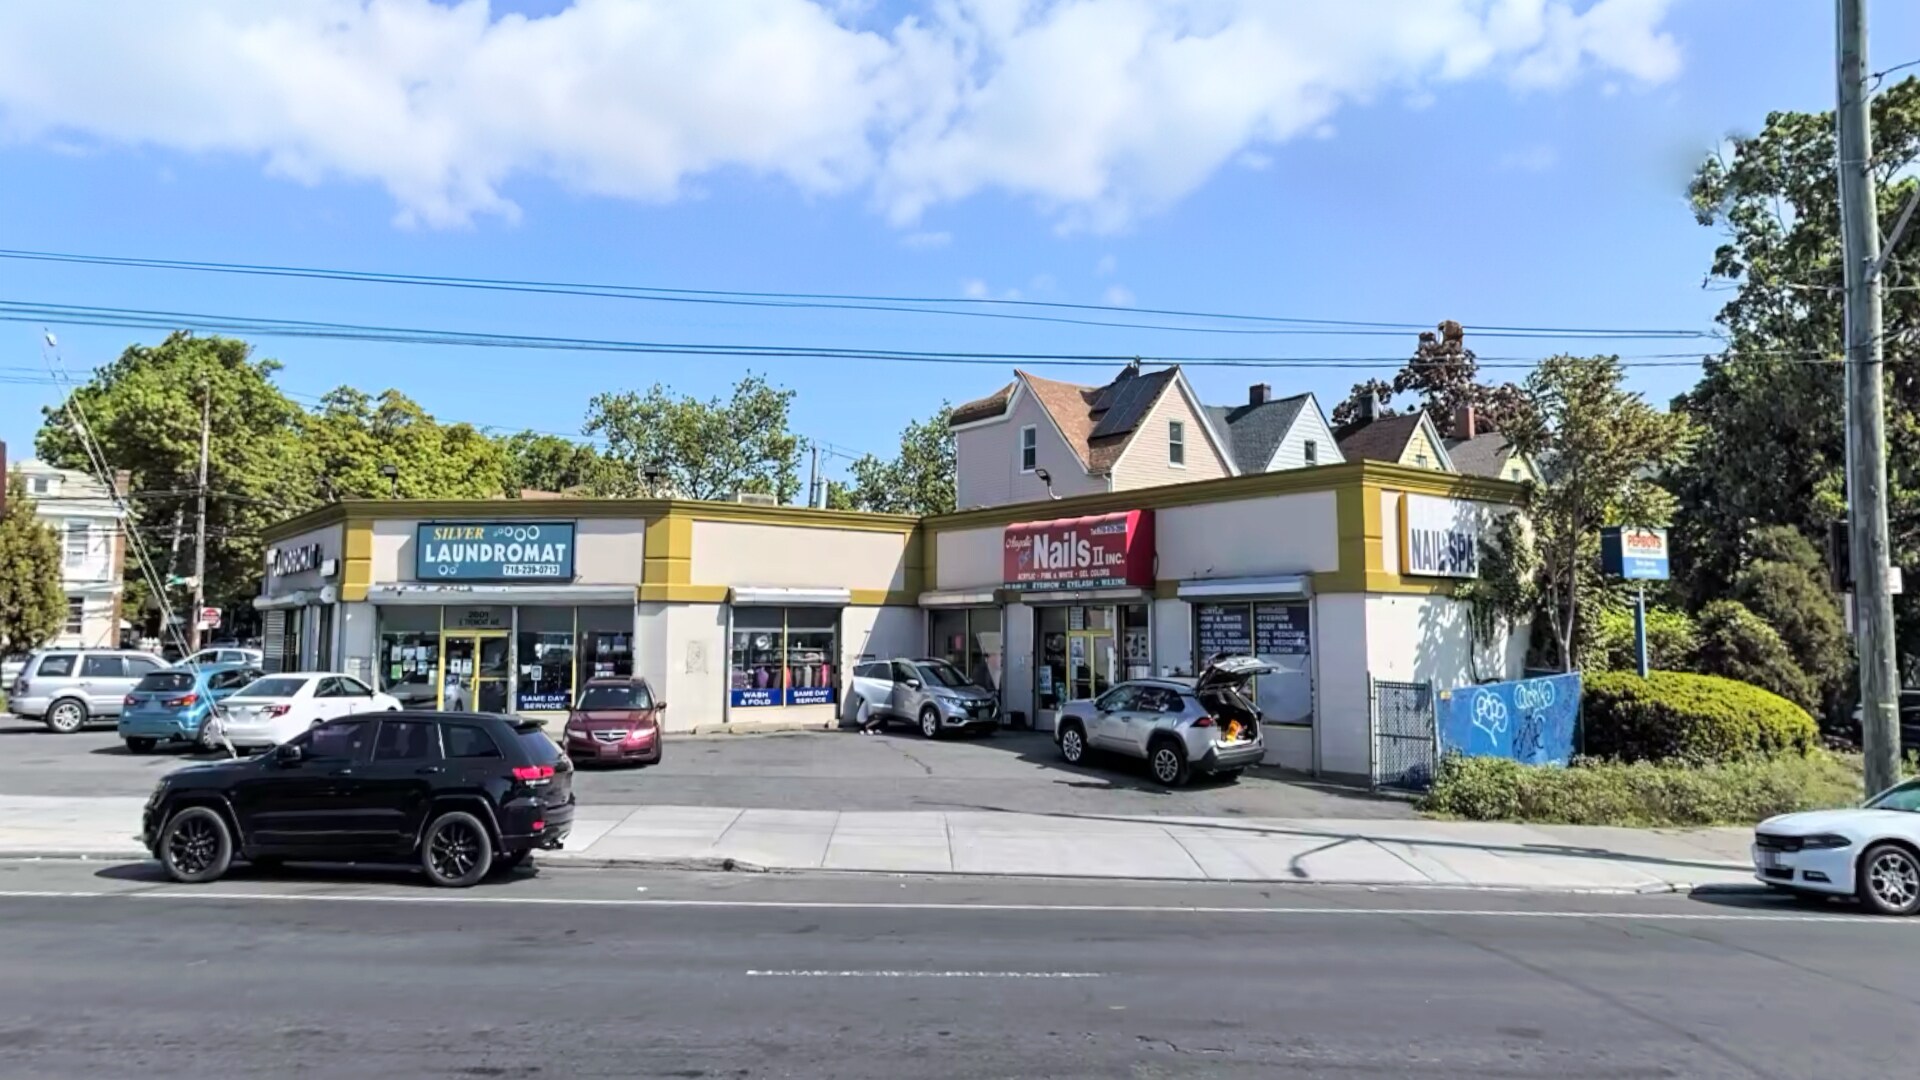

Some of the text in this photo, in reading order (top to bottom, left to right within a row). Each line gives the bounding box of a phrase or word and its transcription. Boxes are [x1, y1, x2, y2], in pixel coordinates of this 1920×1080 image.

[434, 527, 485, 540] SILVER
[425, 543, 566, 563] LAUNDROMAT
[1033, 531, 1091, 569] Nails
[1105, 553, 1125, 565] INC.
[1449, 531, 1475, 573] SPA
[505, 565, 559, 575] 718-239-0713
